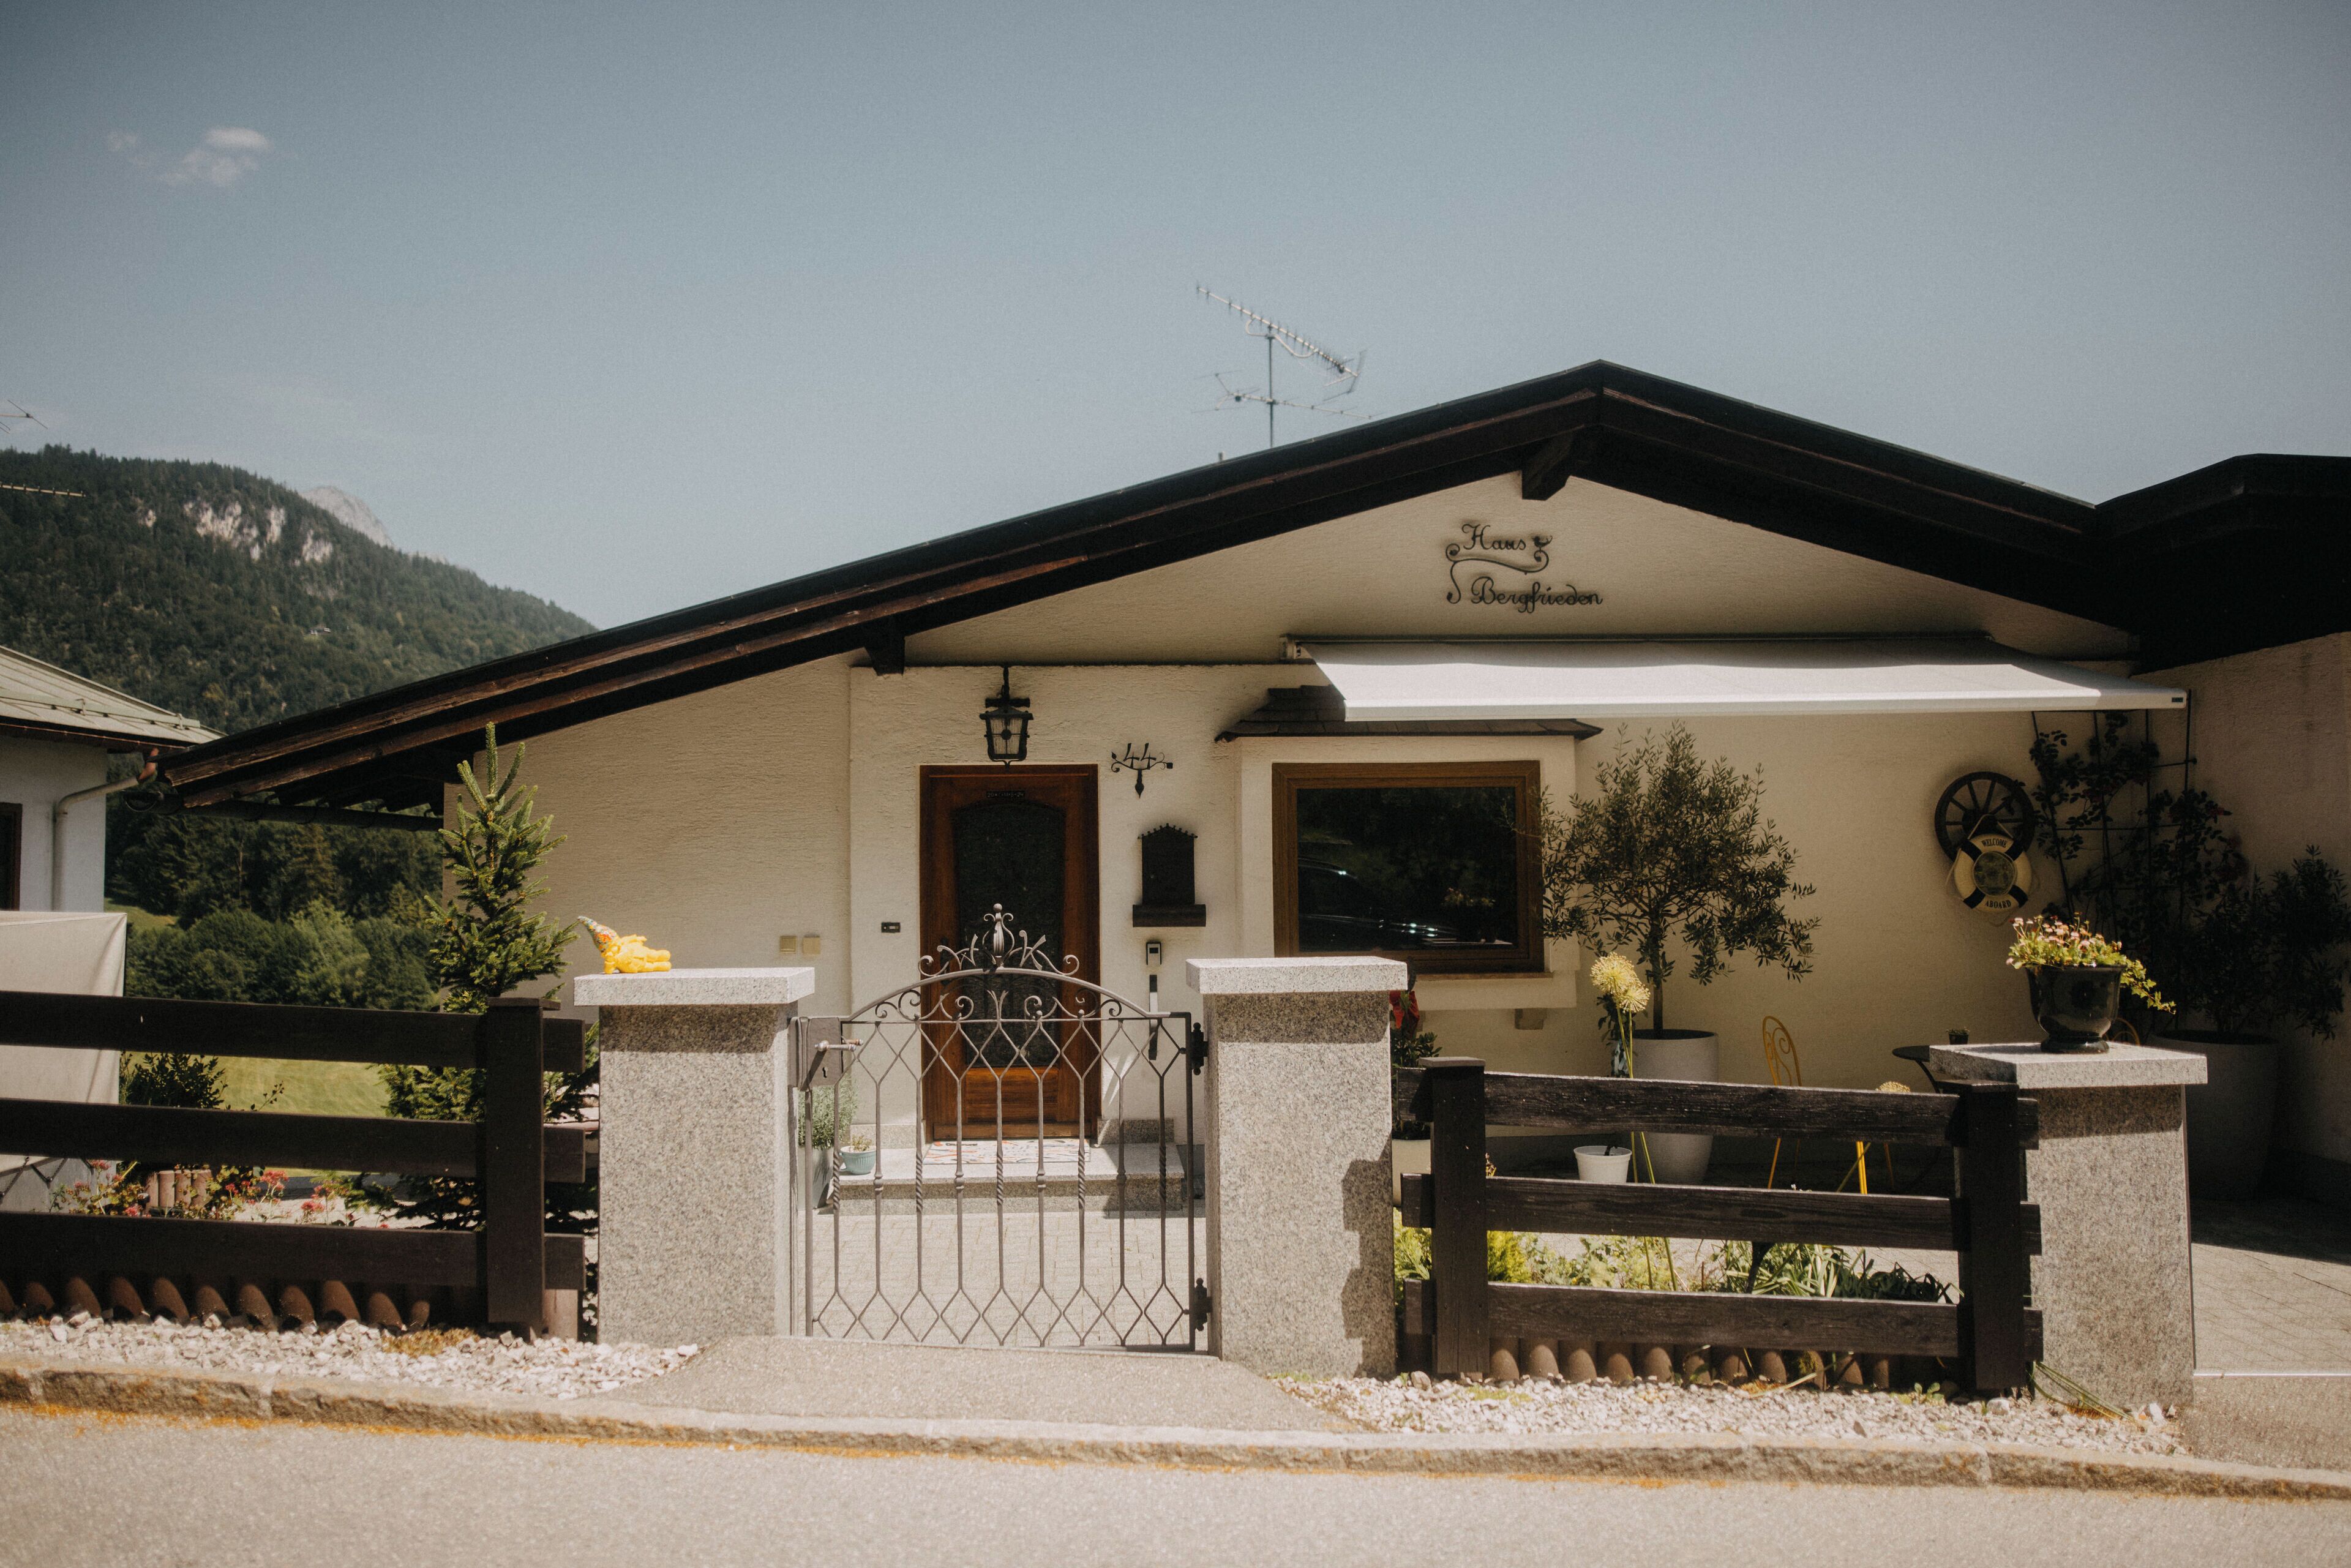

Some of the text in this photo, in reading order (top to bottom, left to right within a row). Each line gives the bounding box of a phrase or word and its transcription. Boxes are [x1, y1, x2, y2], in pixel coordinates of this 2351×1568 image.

[1461, 523, 1526, 550] Haus
[1471, 576, 1603, 613] Bergfrieden
[1123, 742, 1157, 770] 44
[1981, 838, 2008, 849] WELCOME
[1985, 899, 2012, 909] ABOARD
